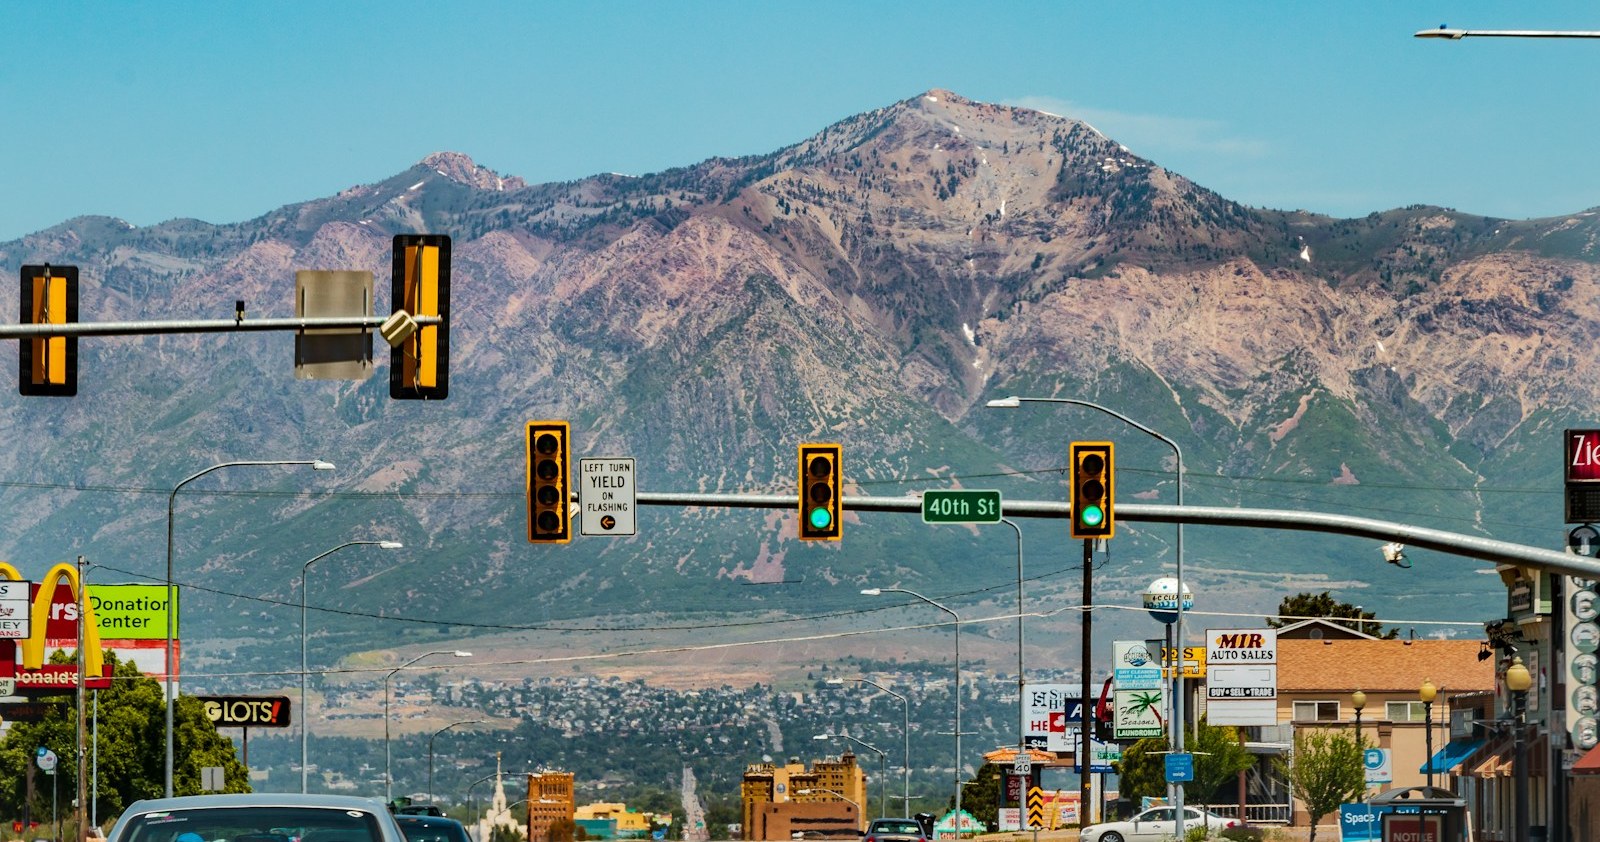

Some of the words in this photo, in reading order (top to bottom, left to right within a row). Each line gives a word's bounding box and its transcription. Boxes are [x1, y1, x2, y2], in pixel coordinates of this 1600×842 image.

[584, 463, 604, 472] LEFT
[609, 463, 630, 472] TURN
[591, 476, 625, 488] YIELD
[602, 491, 614, 500] ON
[587, 503, 628, 512] FLASHING
[929, 497, 970, 516] 40th
[977, 497, 995, 515] St
[1219, 634, 1262, 648] MIR
[1210, 651, 1238, 660] AUTO
[1241, 650, 1273, 660] SALES
[1211, 688, 1225, 697] BUY
[1230, 688, 1246, 697] SELL
[1250, 688, 1273, 697] TRADE
[1120, 718, 1155, 726] Seasons
[1016, 764, 1030, 772] 40
[1344, 812, 1376, 826] Space
